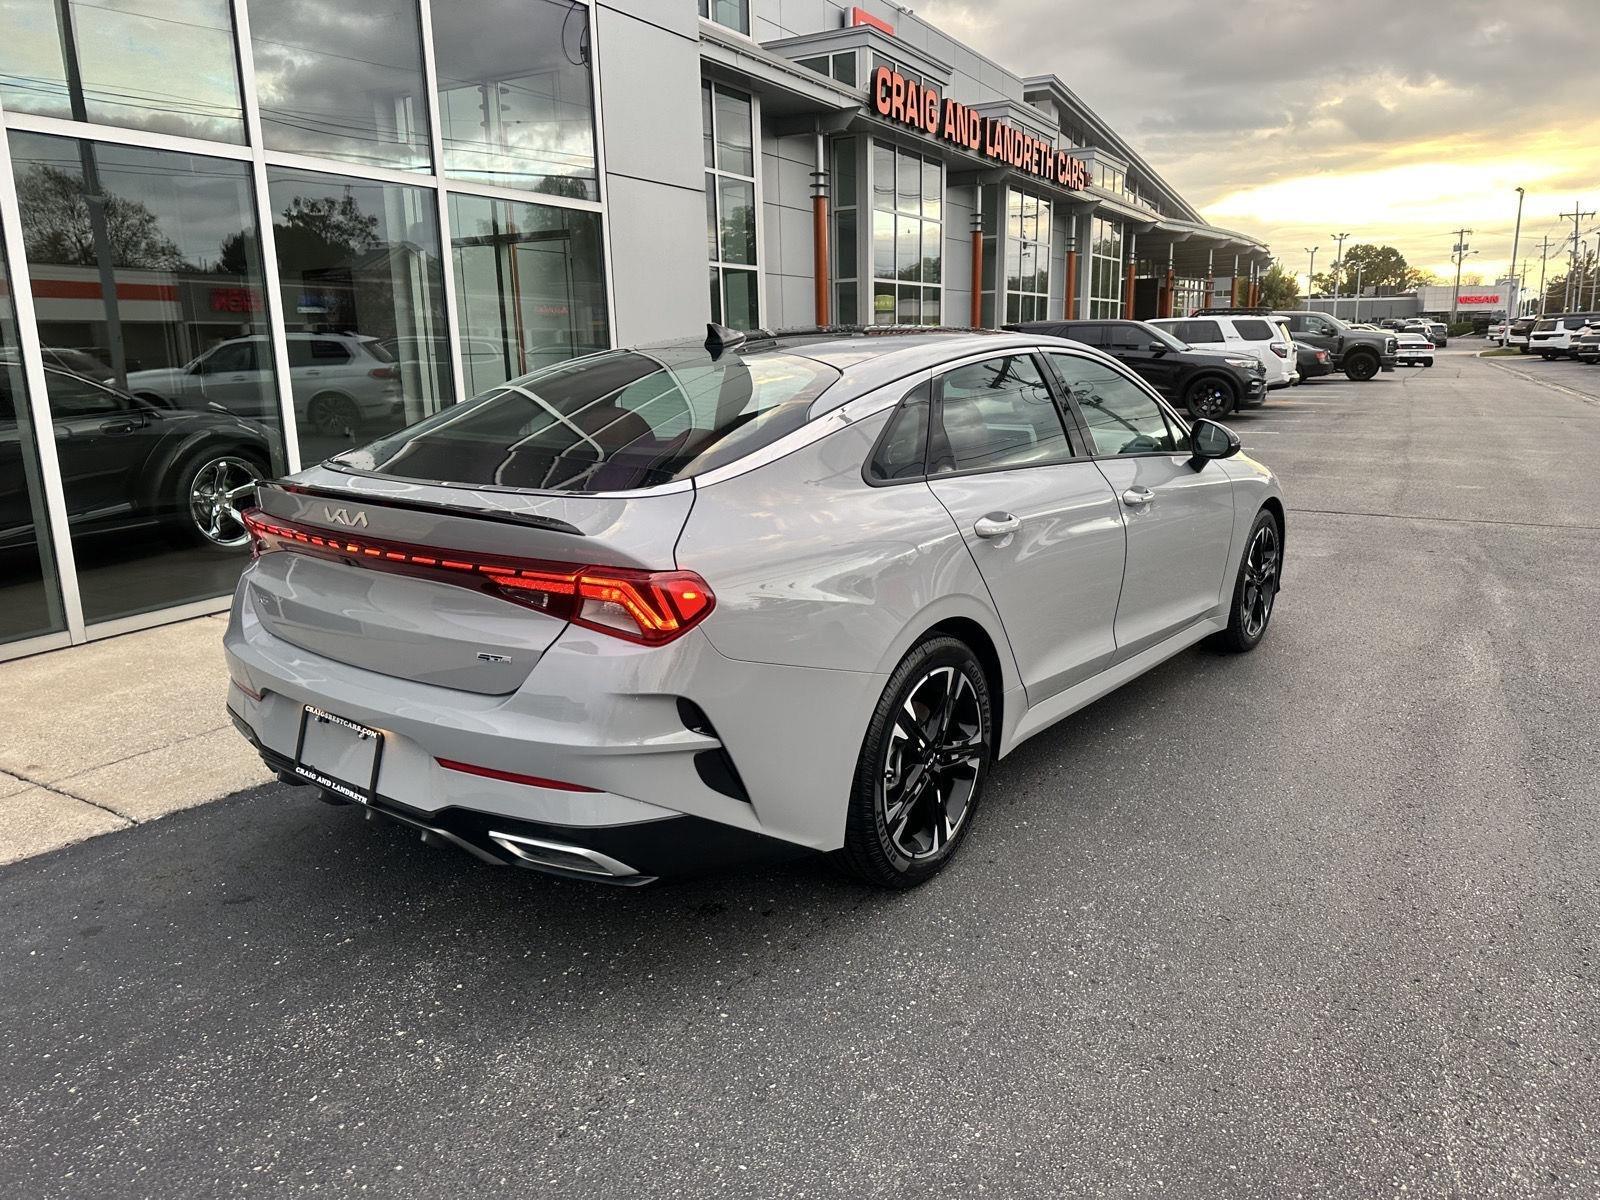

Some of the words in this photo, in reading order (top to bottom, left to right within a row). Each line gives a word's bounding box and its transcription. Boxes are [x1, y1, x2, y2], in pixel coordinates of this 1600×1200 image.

[875, 65, 939, 134] CRAIG
[943, 99, 981, 150] AND
[985, 116, 1054, 180] LANDRETH
[1057, 150, 1085, 191] CARS
[325, 506, 369, 528] KIA
[305, 705, 377, 739] CRAIGSBESTCARS.COM
[969, 664, 990, 735] GOODYEAR
[295, 766, 317, 780] CRAIG
[317, 776, 332, 787] AND
[332, 782, 368, 805] LANDRETH
[876, 810, 898, 863] RELIANT
